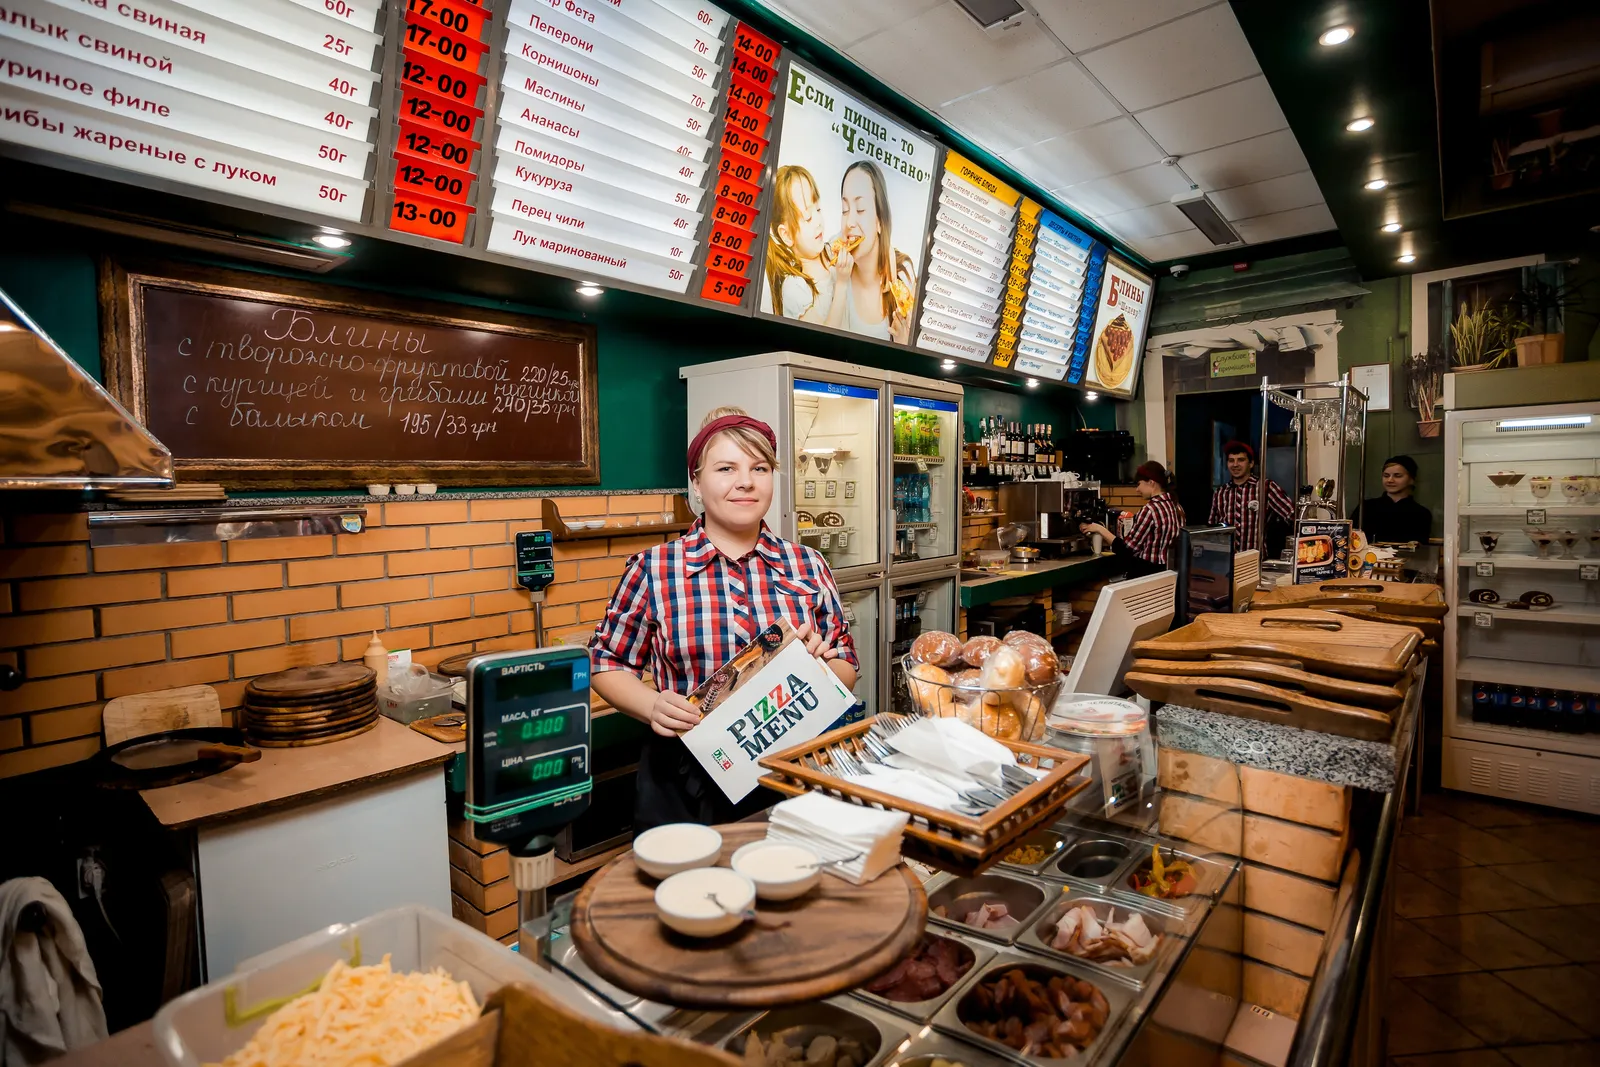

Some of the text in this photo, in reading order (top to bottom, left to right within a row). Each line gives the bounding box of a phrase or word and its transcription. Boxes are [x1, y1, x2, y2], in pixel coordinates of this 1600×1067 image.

[118, 3, 206, 44] свиная
[324, 0, 354, 19] 60г
[408, 0, 469, 33] 17-00
[697, 9, 713, 26] 60г
[565, 0, 709, 55] Фета 70г
[78, 33, 173, 74] свиной
[322, 34, 354, 56] 25г
[407, 23, 467, 62] 17-00
[529, 14, 707, 81] Пеперони 50г
[737, 34, 773, 61] 14-00
[403, 61, 467, 99] 12-00
[521, 43, 706, 110] Корнишоны 70г
[732, 57, 768, 83] 14-00
[328, 77, 358, 97] 40г
[729, 83, 763, 109] 14-00
[103, 87, 170, 117] филе
[407, 97, 470, 132] 12-00
[524, 78, 702, 133] Маслины 50г
[787, 68, 835, 113] Если
[843, 105, 887, 142] пицца
[901, 137, 914, 156] то
[324, 111, 354, 130] 40г
[520, 108, 580, 138] Ананасы
[725, 107, 759, 132] 14-00
[0, 106, 277, 187] ибы жареные с луком
[318, 145, 347, 163] 50г
[406, 132, 468, 165] 12-00
[724, 131, 759, 155] 10-00
[514, 140, 694, 179] Помидоры 40г
[721, 159, 753, 180] 9-00
[318, 185, 347, 203] 50г
[400, 165, 463, 196] 12-00
[515, 165, 691, 205] Кукуруза 50г
[721, 185, 753, 206] 8-00
[394, 201, 456, 228] 13-00
[511, 199, 689, 230] Перец чили 40г
[716, 206, 747, 226] 8-00
[670, 246, 684, 258] 10г
[712, 232, 742, 250] 8-00
[513, 230, 684, 281] Лук маринованный 50г
[713, 254, 744, 272] 5-00
[713, 280, 745, 298] 5-00
[264, 308, 433, 354] Блины
[178, 337, 192, 356] с
[183, 374, 197, 394] с
[206, 374, 334, 408] курицей
[380, 380, 488, 417] грибами
[186, 405, 198, 425] с
[230, 402, 372, 430] балыком
[501, 662, 545, 676] ВАРТІСТЬ
[501, 708, 542, 723] МАСА, КГ
[726, 673, 809, 744] PIZZA
[740, 686, 820, 761] MENU
[501, 755, 524, 768] ЦІНА
